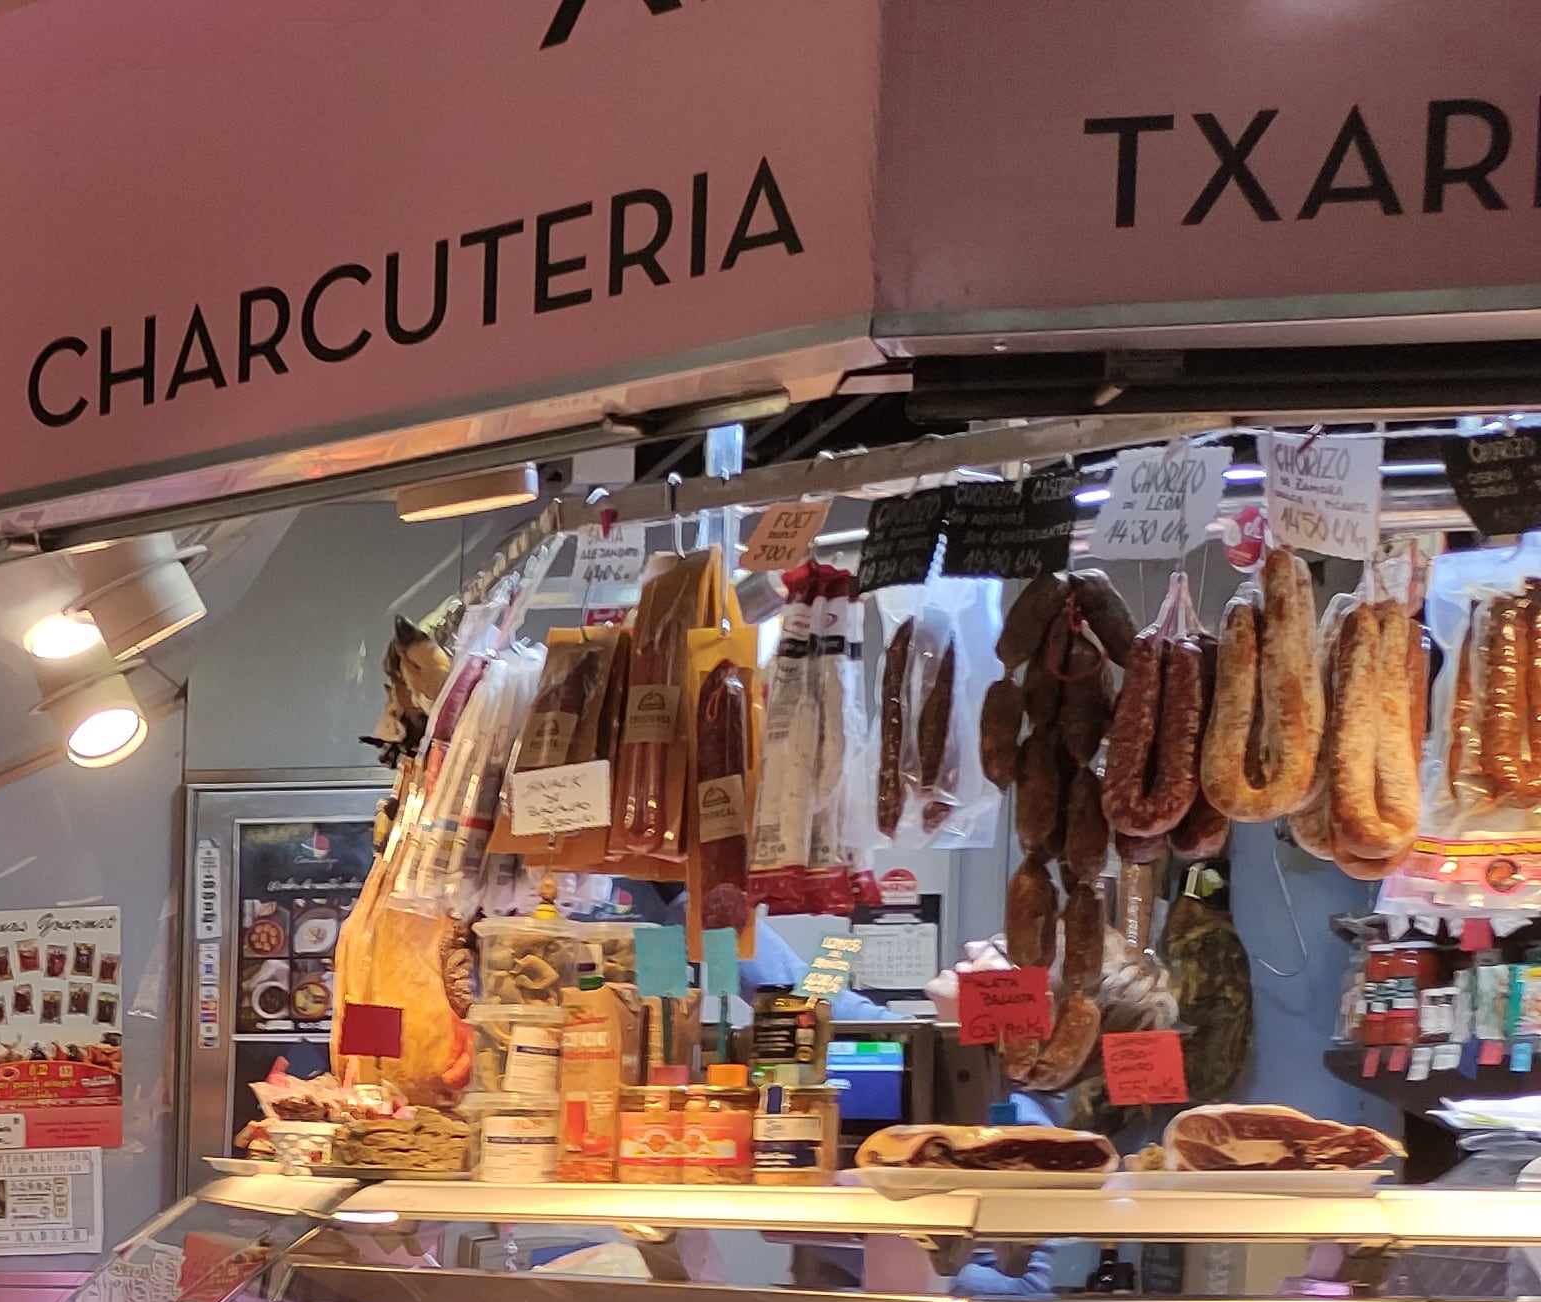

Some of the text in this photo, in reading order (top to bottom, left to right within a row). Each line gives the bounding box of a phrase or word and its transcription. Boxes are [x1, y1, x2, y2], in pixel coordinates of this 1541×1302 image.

[1083, 97, 1541, 230] TXAR
[27, 156, 804, 428] CHARCUTERIA
[773, 511, 818, 529] FUET
